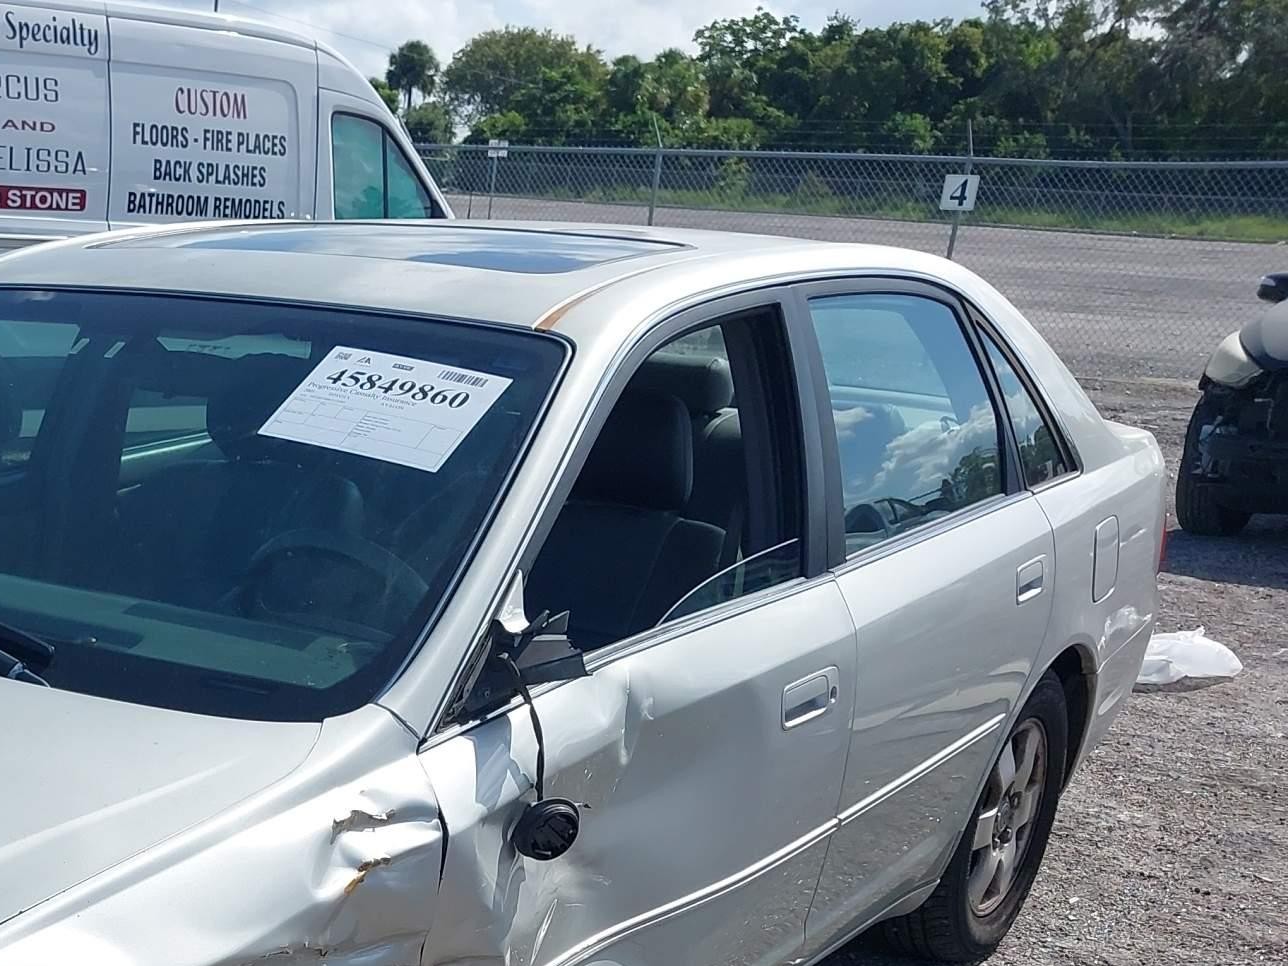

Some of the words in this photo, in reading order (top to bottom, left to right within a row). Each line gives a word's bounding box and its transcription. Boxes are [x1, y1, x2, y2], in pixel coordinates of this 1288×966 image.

[5, 11, 99, 55] Specialty
[175, 87, 247, 120] CUSTOM
[1, 119, 55, 133] AND
[132, 122, 189, 149] FLOORS
[203, 129, 232, 152] FIRE
[236, 131, 287, 157] PLACES
[153, 158, 193, 183] BACK
[196, 161, 267, 188] SPLASHES
[6, 191, 81, 210] STONE
[127, 191, 209, 217] BATHROOM
[212, 196, 285, 220] REMODELS
[950, 179, 968, 206] 4
[326, 368, 470, 409] 45849860
